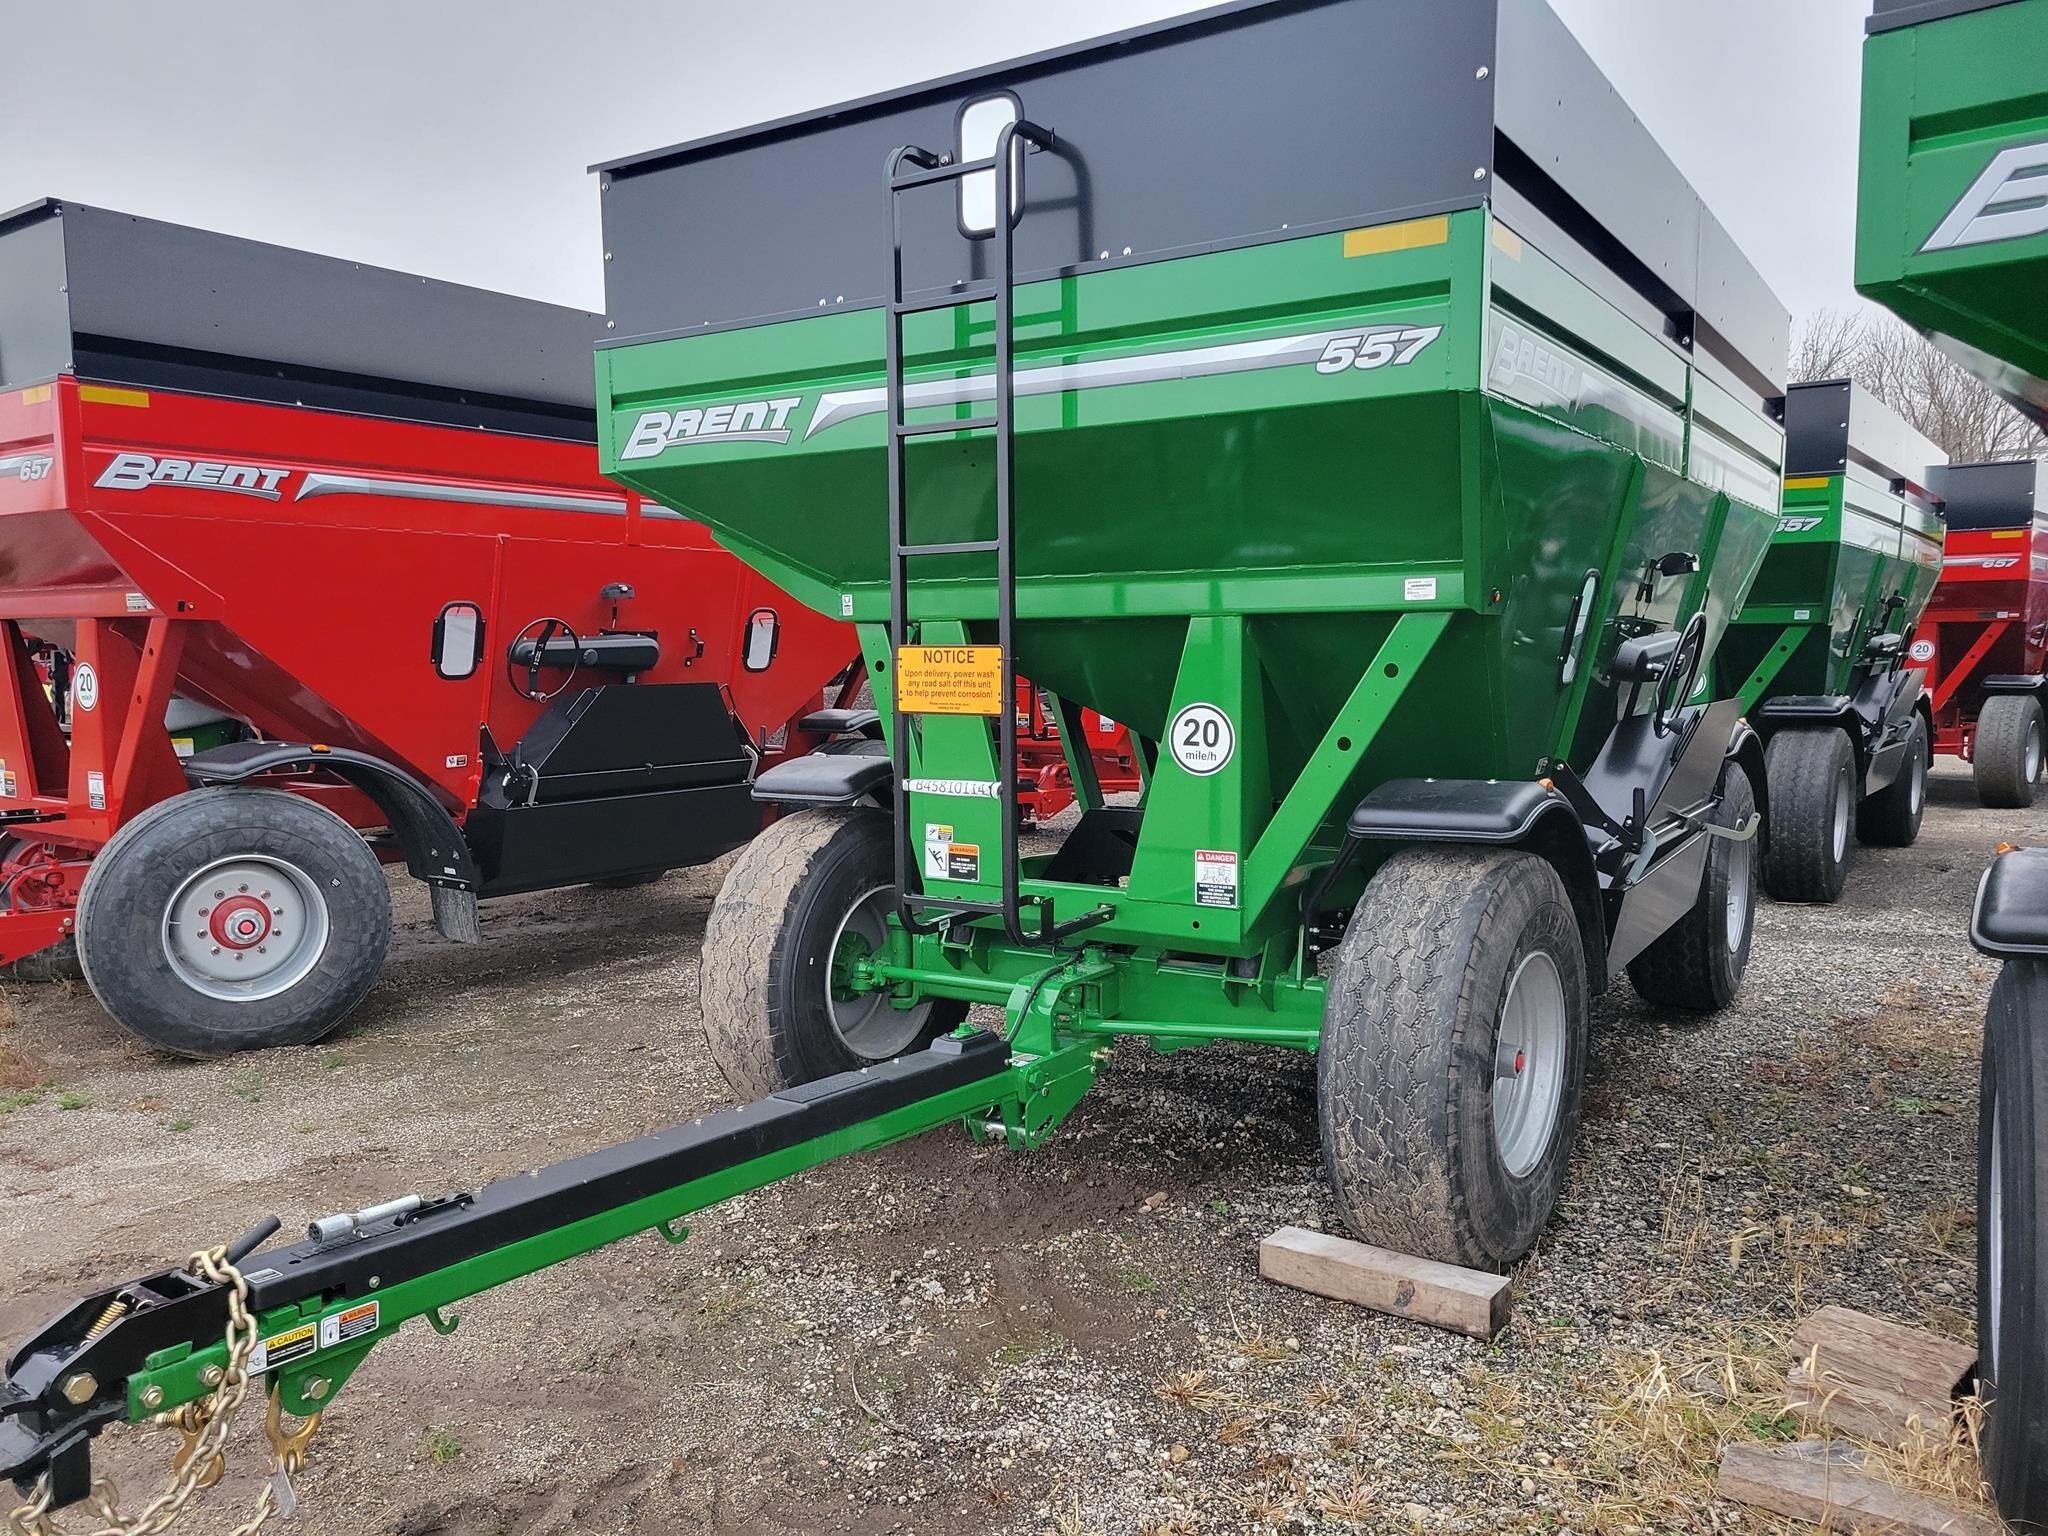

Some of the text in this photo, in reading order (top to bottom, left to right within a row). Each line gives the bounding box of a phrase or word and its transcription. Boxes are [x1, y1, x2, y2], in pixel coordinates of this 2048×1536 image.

[1316, 324, 1444, 375] 557
[620, 395, 803, 461] BRENT
[20, 457, 54, 481] 657
[92, 453, 291, 494] BRENT
[1982, 558, 2020, 568] 657
[1915, 644, 1930, 654] 20
[923, 650, 975, 664] NOTICE
[904, 669, 995, 680] Upon delivery, power wash
[79, 673, 93, 692] 20
[908, 680, 992, 689] any road salt off this unit
[906, 689, 993, 699] to help prevent corrosion!
[1183, 718, 1220, 748] 20
[1185, 750, 1217, 762] mile/h
[1205, 853, 1235, 863] DANGER
[347, 1304, 376, 1319] WARNING
[277, 1326, 313, 1346] CAUTION
